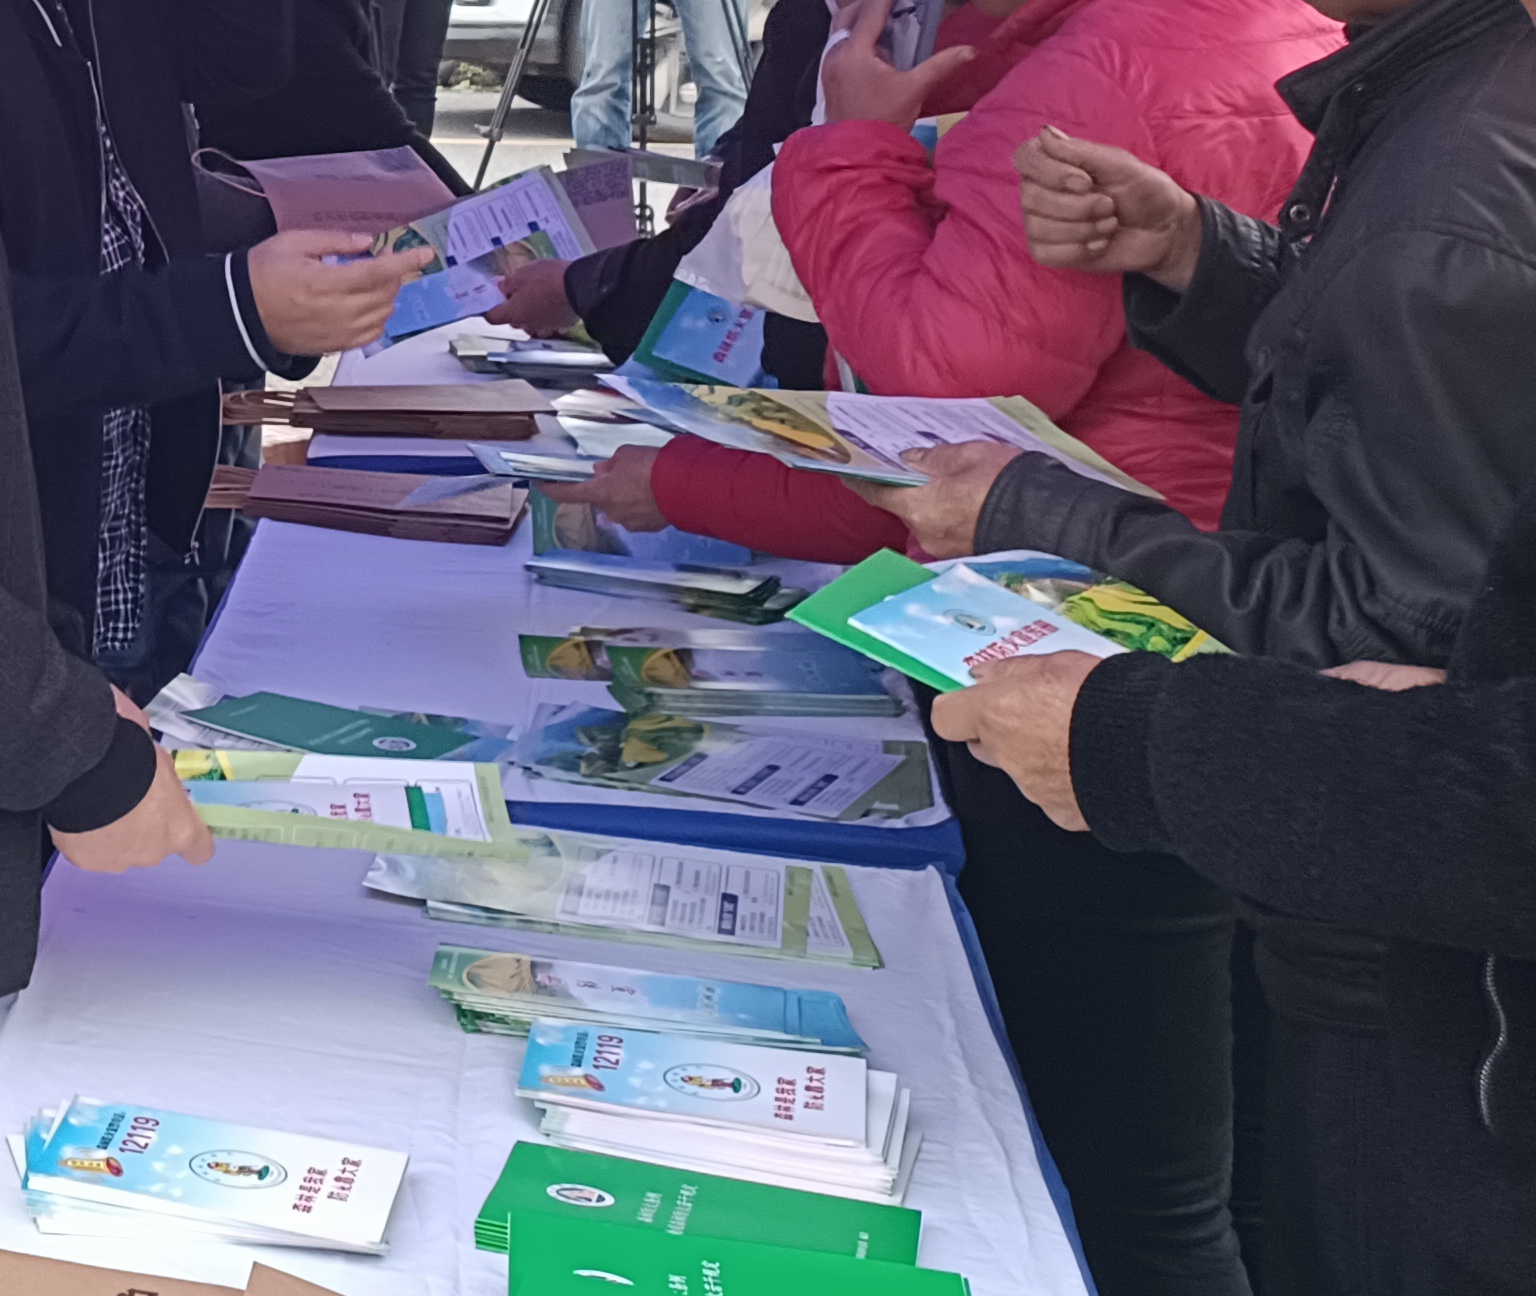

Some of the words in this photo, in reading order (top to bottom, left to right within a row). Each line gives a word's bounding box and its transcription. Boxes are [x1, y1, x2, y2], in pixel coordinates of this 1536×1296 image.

[592, 1034, 624, 1071] 12119
[774, 1077, 797, 1121] 森林是我家
[118, 1116, 160, 1155] 12119
[292, 1166, 328, 1214] 森林是我家
